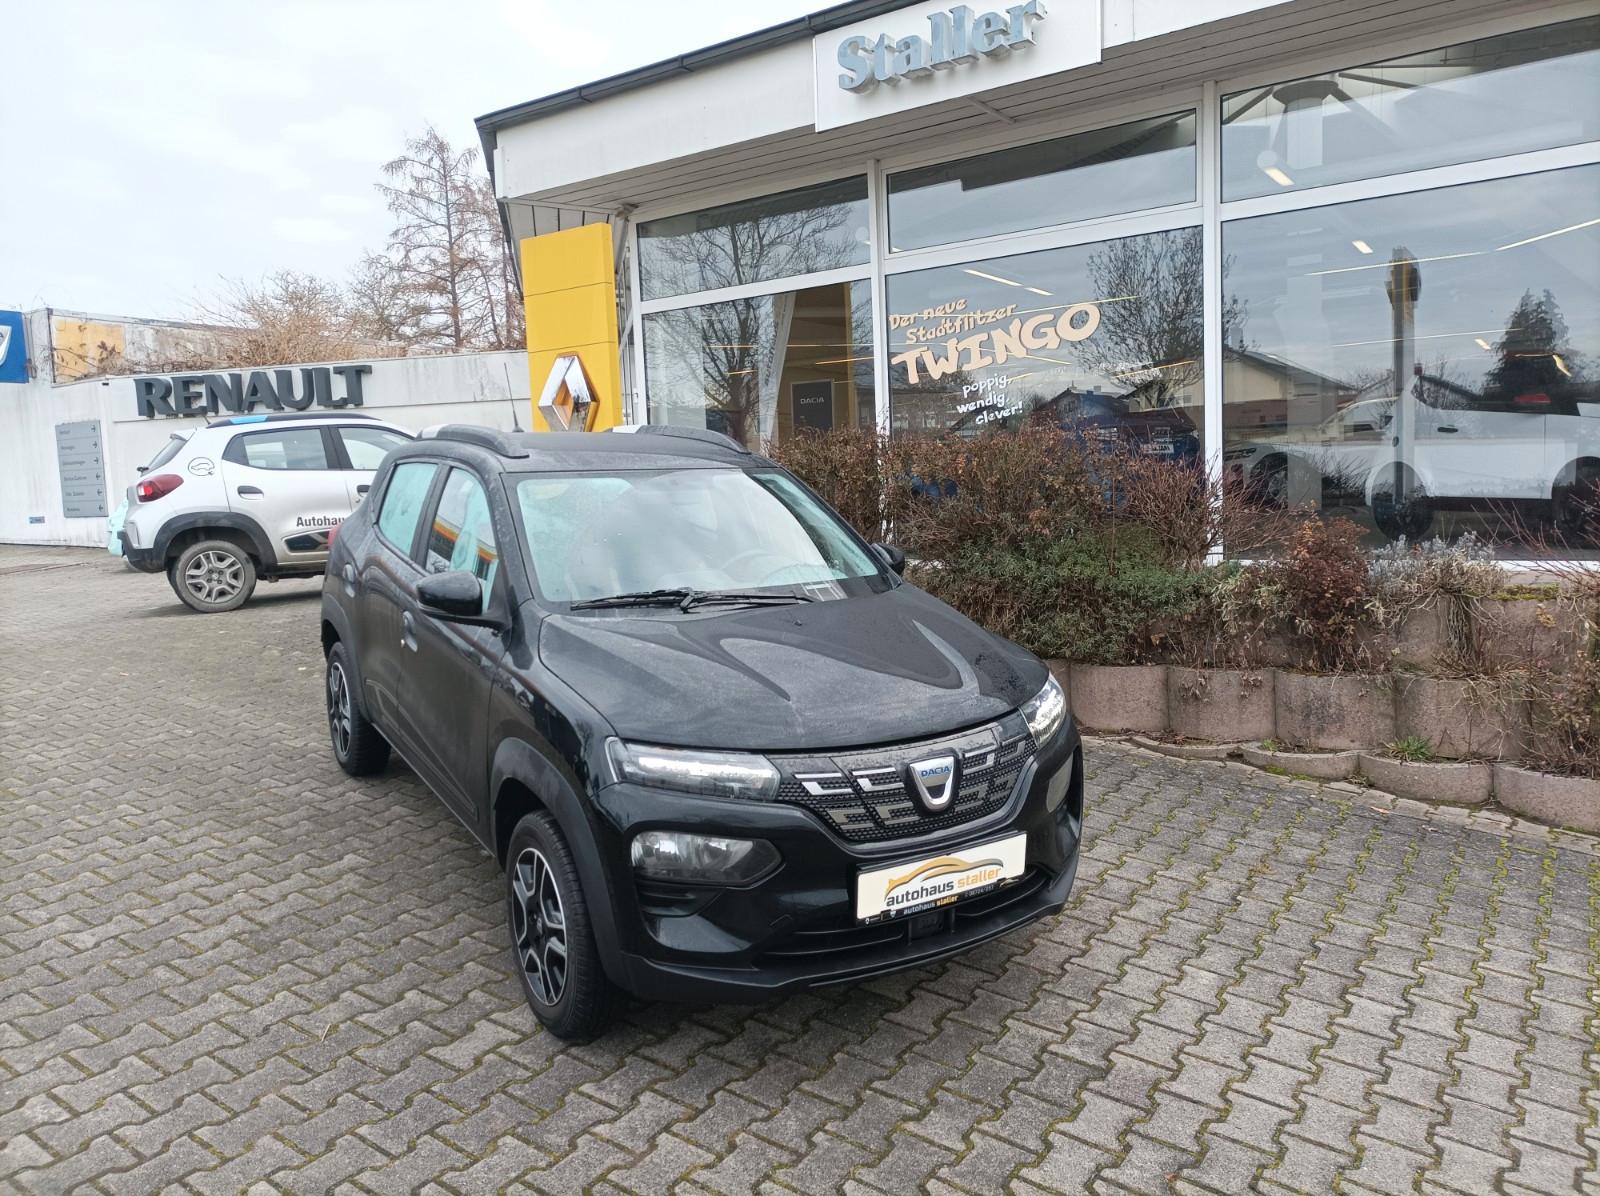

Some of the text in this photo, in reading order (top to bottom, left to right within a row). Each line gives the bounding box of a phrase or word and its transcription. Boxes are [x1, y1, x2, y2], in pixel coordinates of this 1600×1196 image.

[838, 0, 1046, 94] Staller
[889, 298, 967, 330] Der neue
[906, 303, 1017, 344] Stadtflitzer
[891, 303, 1101, 385] TWINGO
[134, 364, 373, 418] RENAULT
[962, 373, 1012, 398] poppig,
[800, 396, 825, 405] DACIA
[956, 391, 1010, 413] wendig,
[975, 401, 1023, 424] clever!
[921, 766, 950, 777] DACIA
[886, 867, 1002, 907] autohaus staller
[903, 901, 936, 915] autohaus
[936, 894, 960, 906] staller
